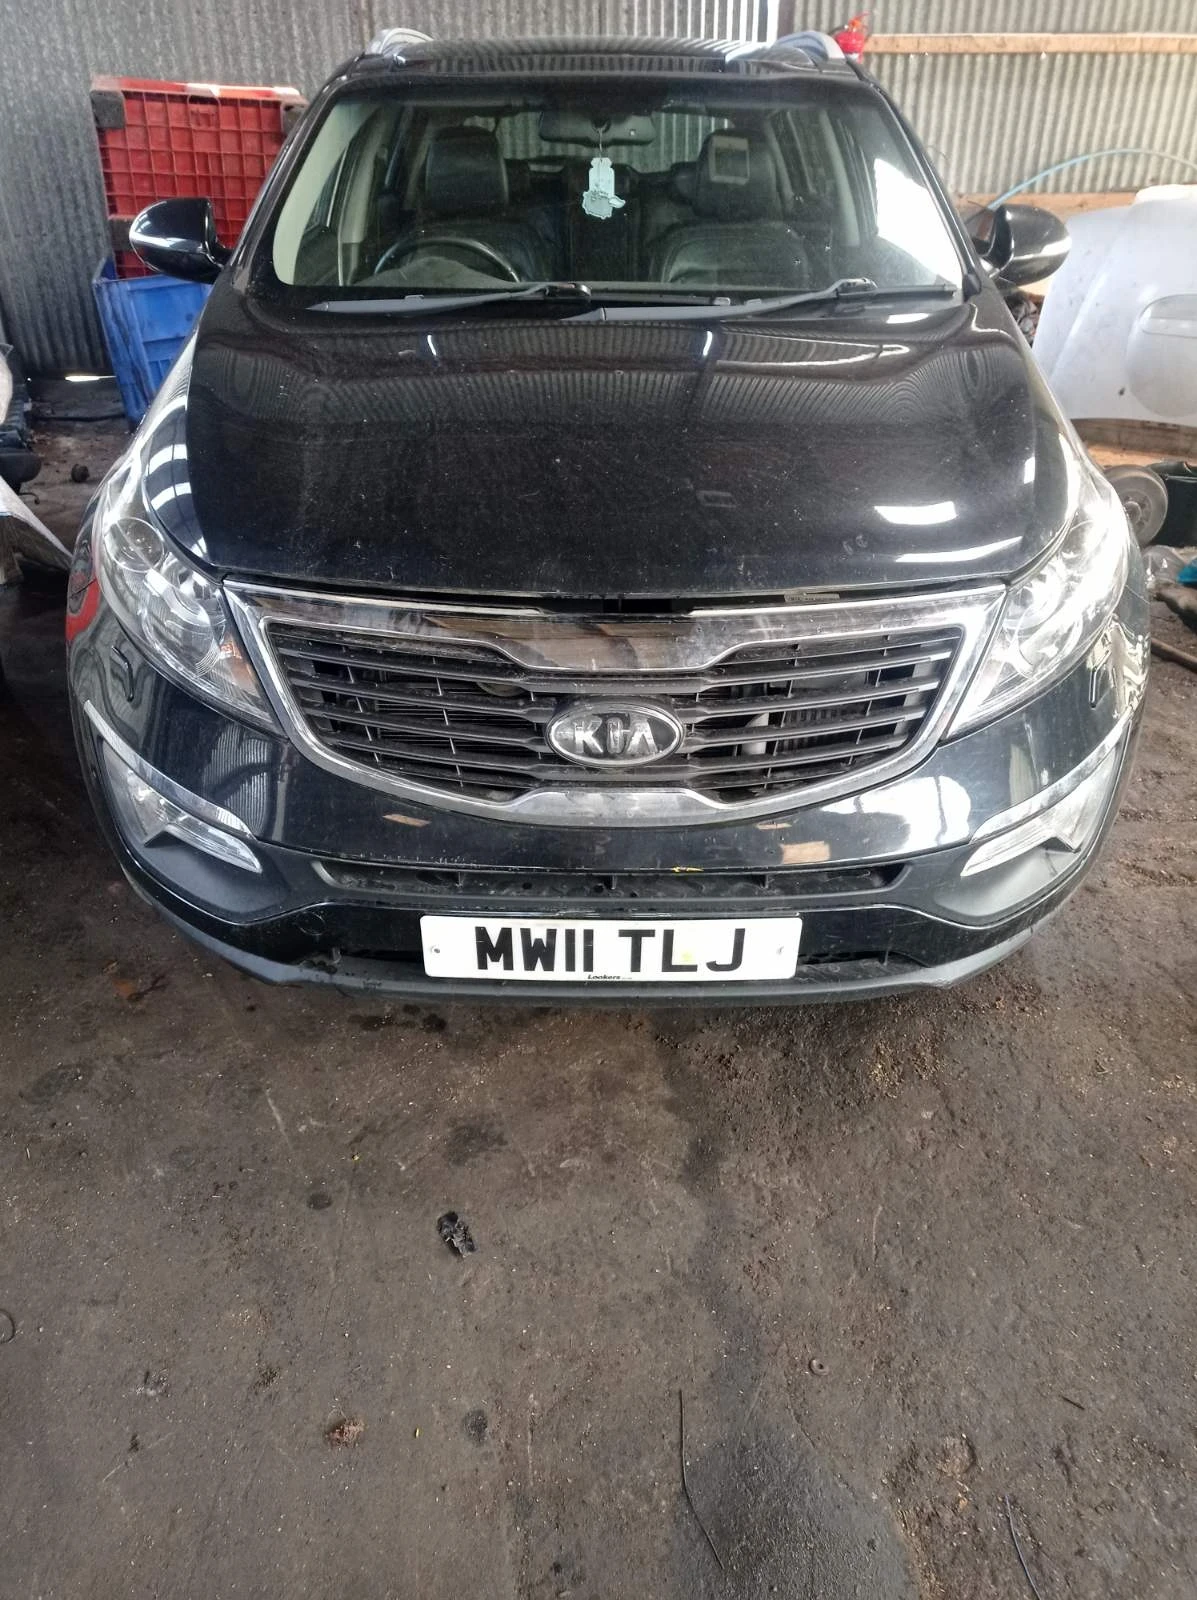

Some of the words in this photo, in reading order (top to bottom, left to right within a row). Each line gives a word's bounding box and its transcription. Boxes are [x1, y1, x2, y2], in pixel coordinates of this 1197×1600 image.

[574, 717, 659, 754] KIA
[475, 926, 594, 973] MW11
[618, 928, 746, 973] TLJ
